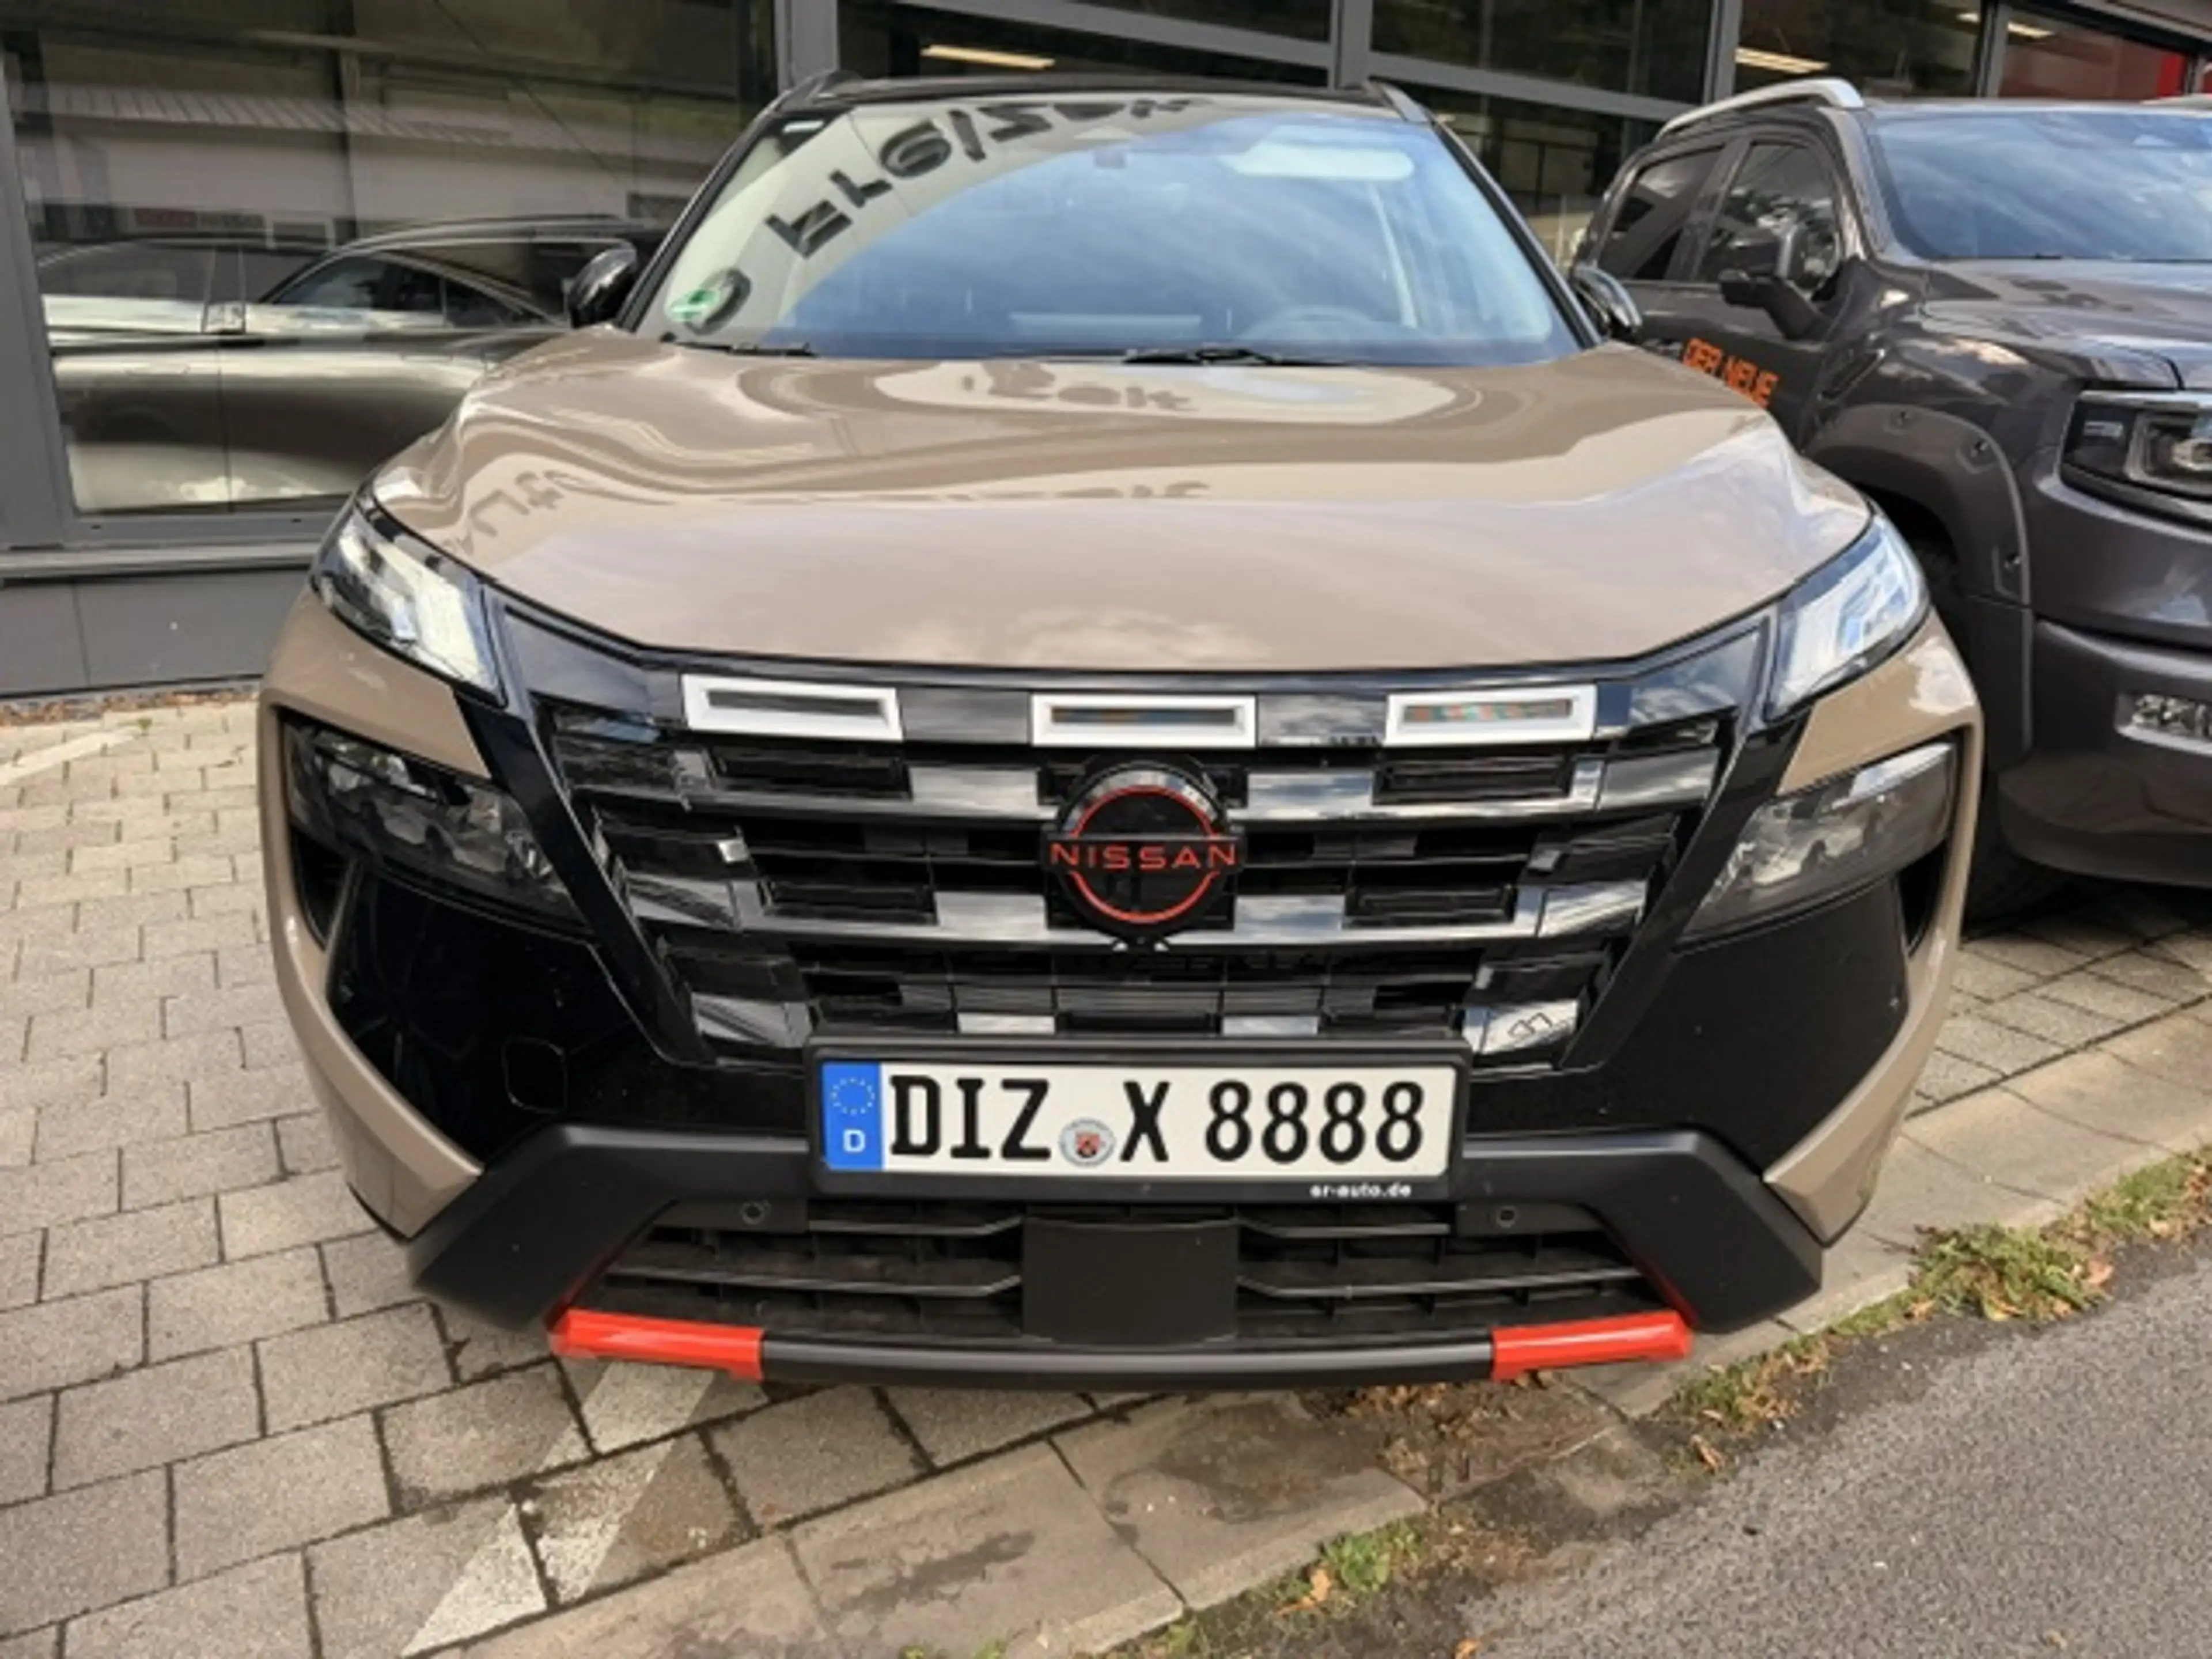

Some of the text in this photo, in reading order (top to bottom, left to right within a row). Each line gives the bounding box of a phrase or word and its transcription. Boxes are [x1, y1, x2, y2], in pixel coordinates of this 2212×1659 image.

[1050, 843, 1237, 871] NISSAN
[890, 1074, 1423, 1164] DIZ X 8888
[843, 1129, 865, 1153] D
